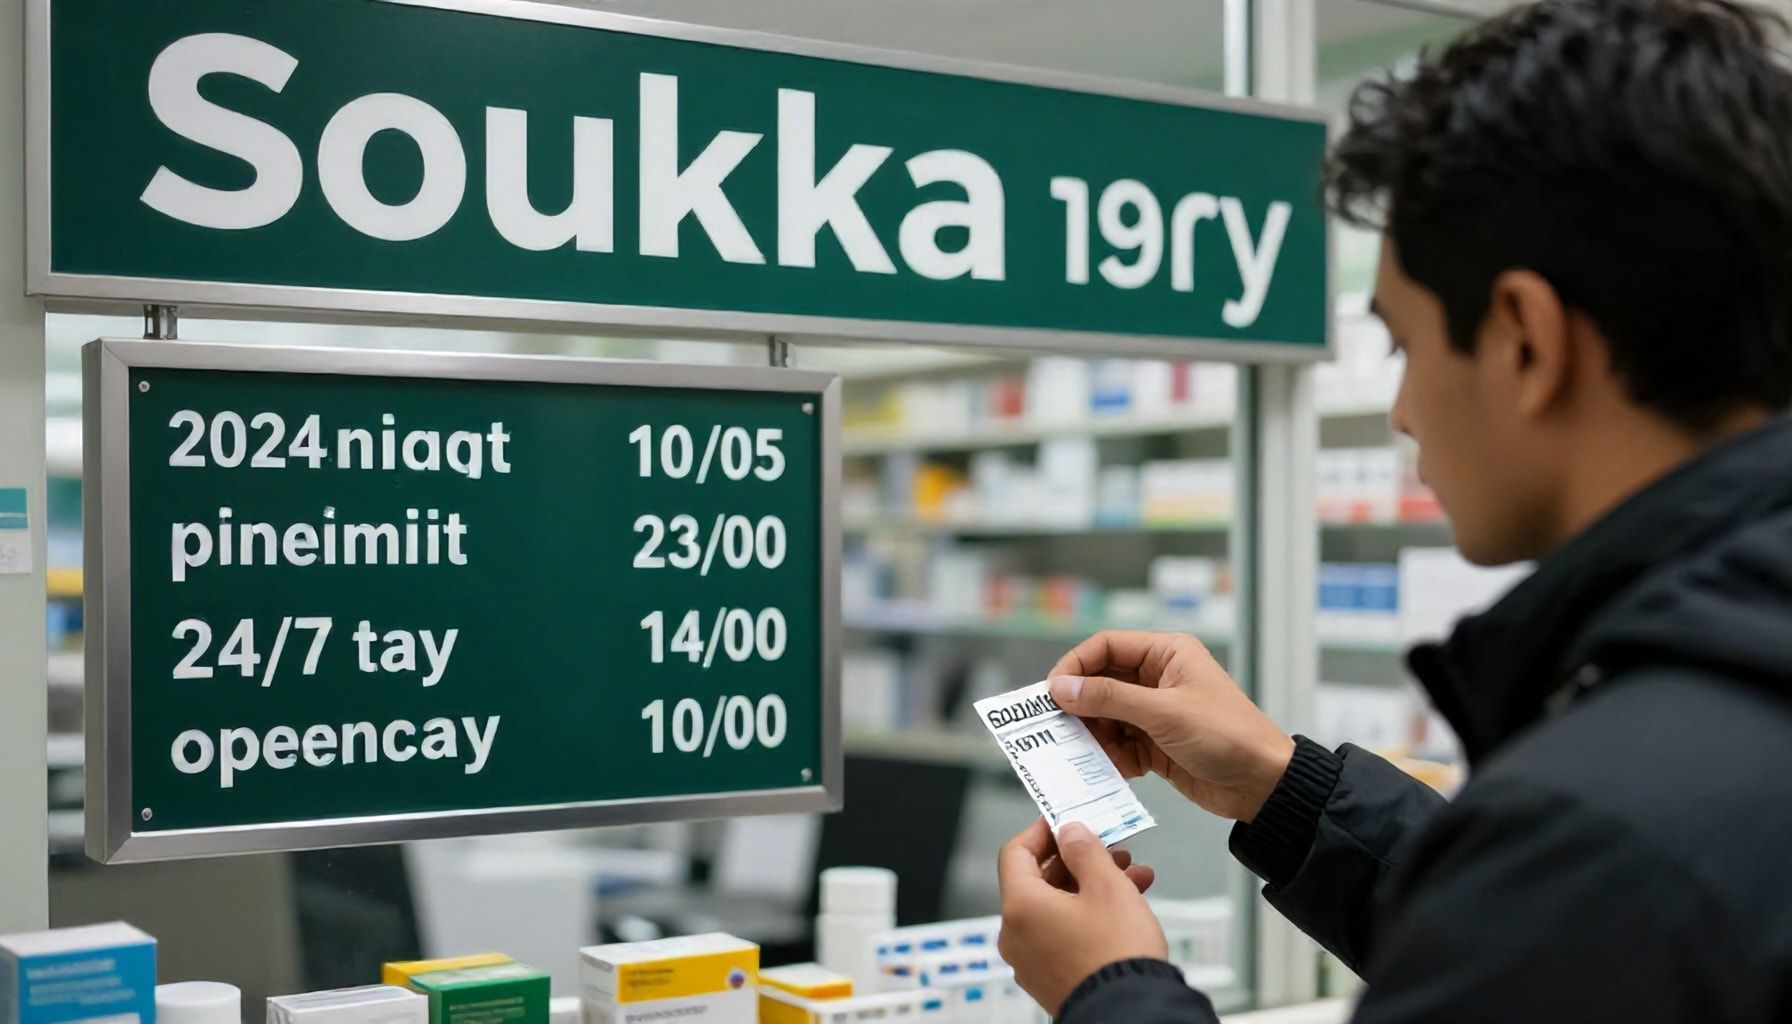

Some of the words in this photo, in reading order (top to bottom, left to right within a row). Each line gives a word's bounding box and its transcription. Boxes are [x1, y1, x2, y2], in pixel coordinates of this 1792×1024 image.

[140, 32, 1005, 281] Soukka
[1050, 176, 1292, 329] 19ry
[629, 424, 786, 484] 10/05
[171, 506, 468, 582] pineimiit
[633, 514, 786, 576] 23/00
[171, 616, 333, 687] 24/7
[352, 619, 459, 687] tay
[640, 607, 787, 668] 14/00
[170, 715, 501, 789] opeencay
[641, 694, 787, 758] 10/00
